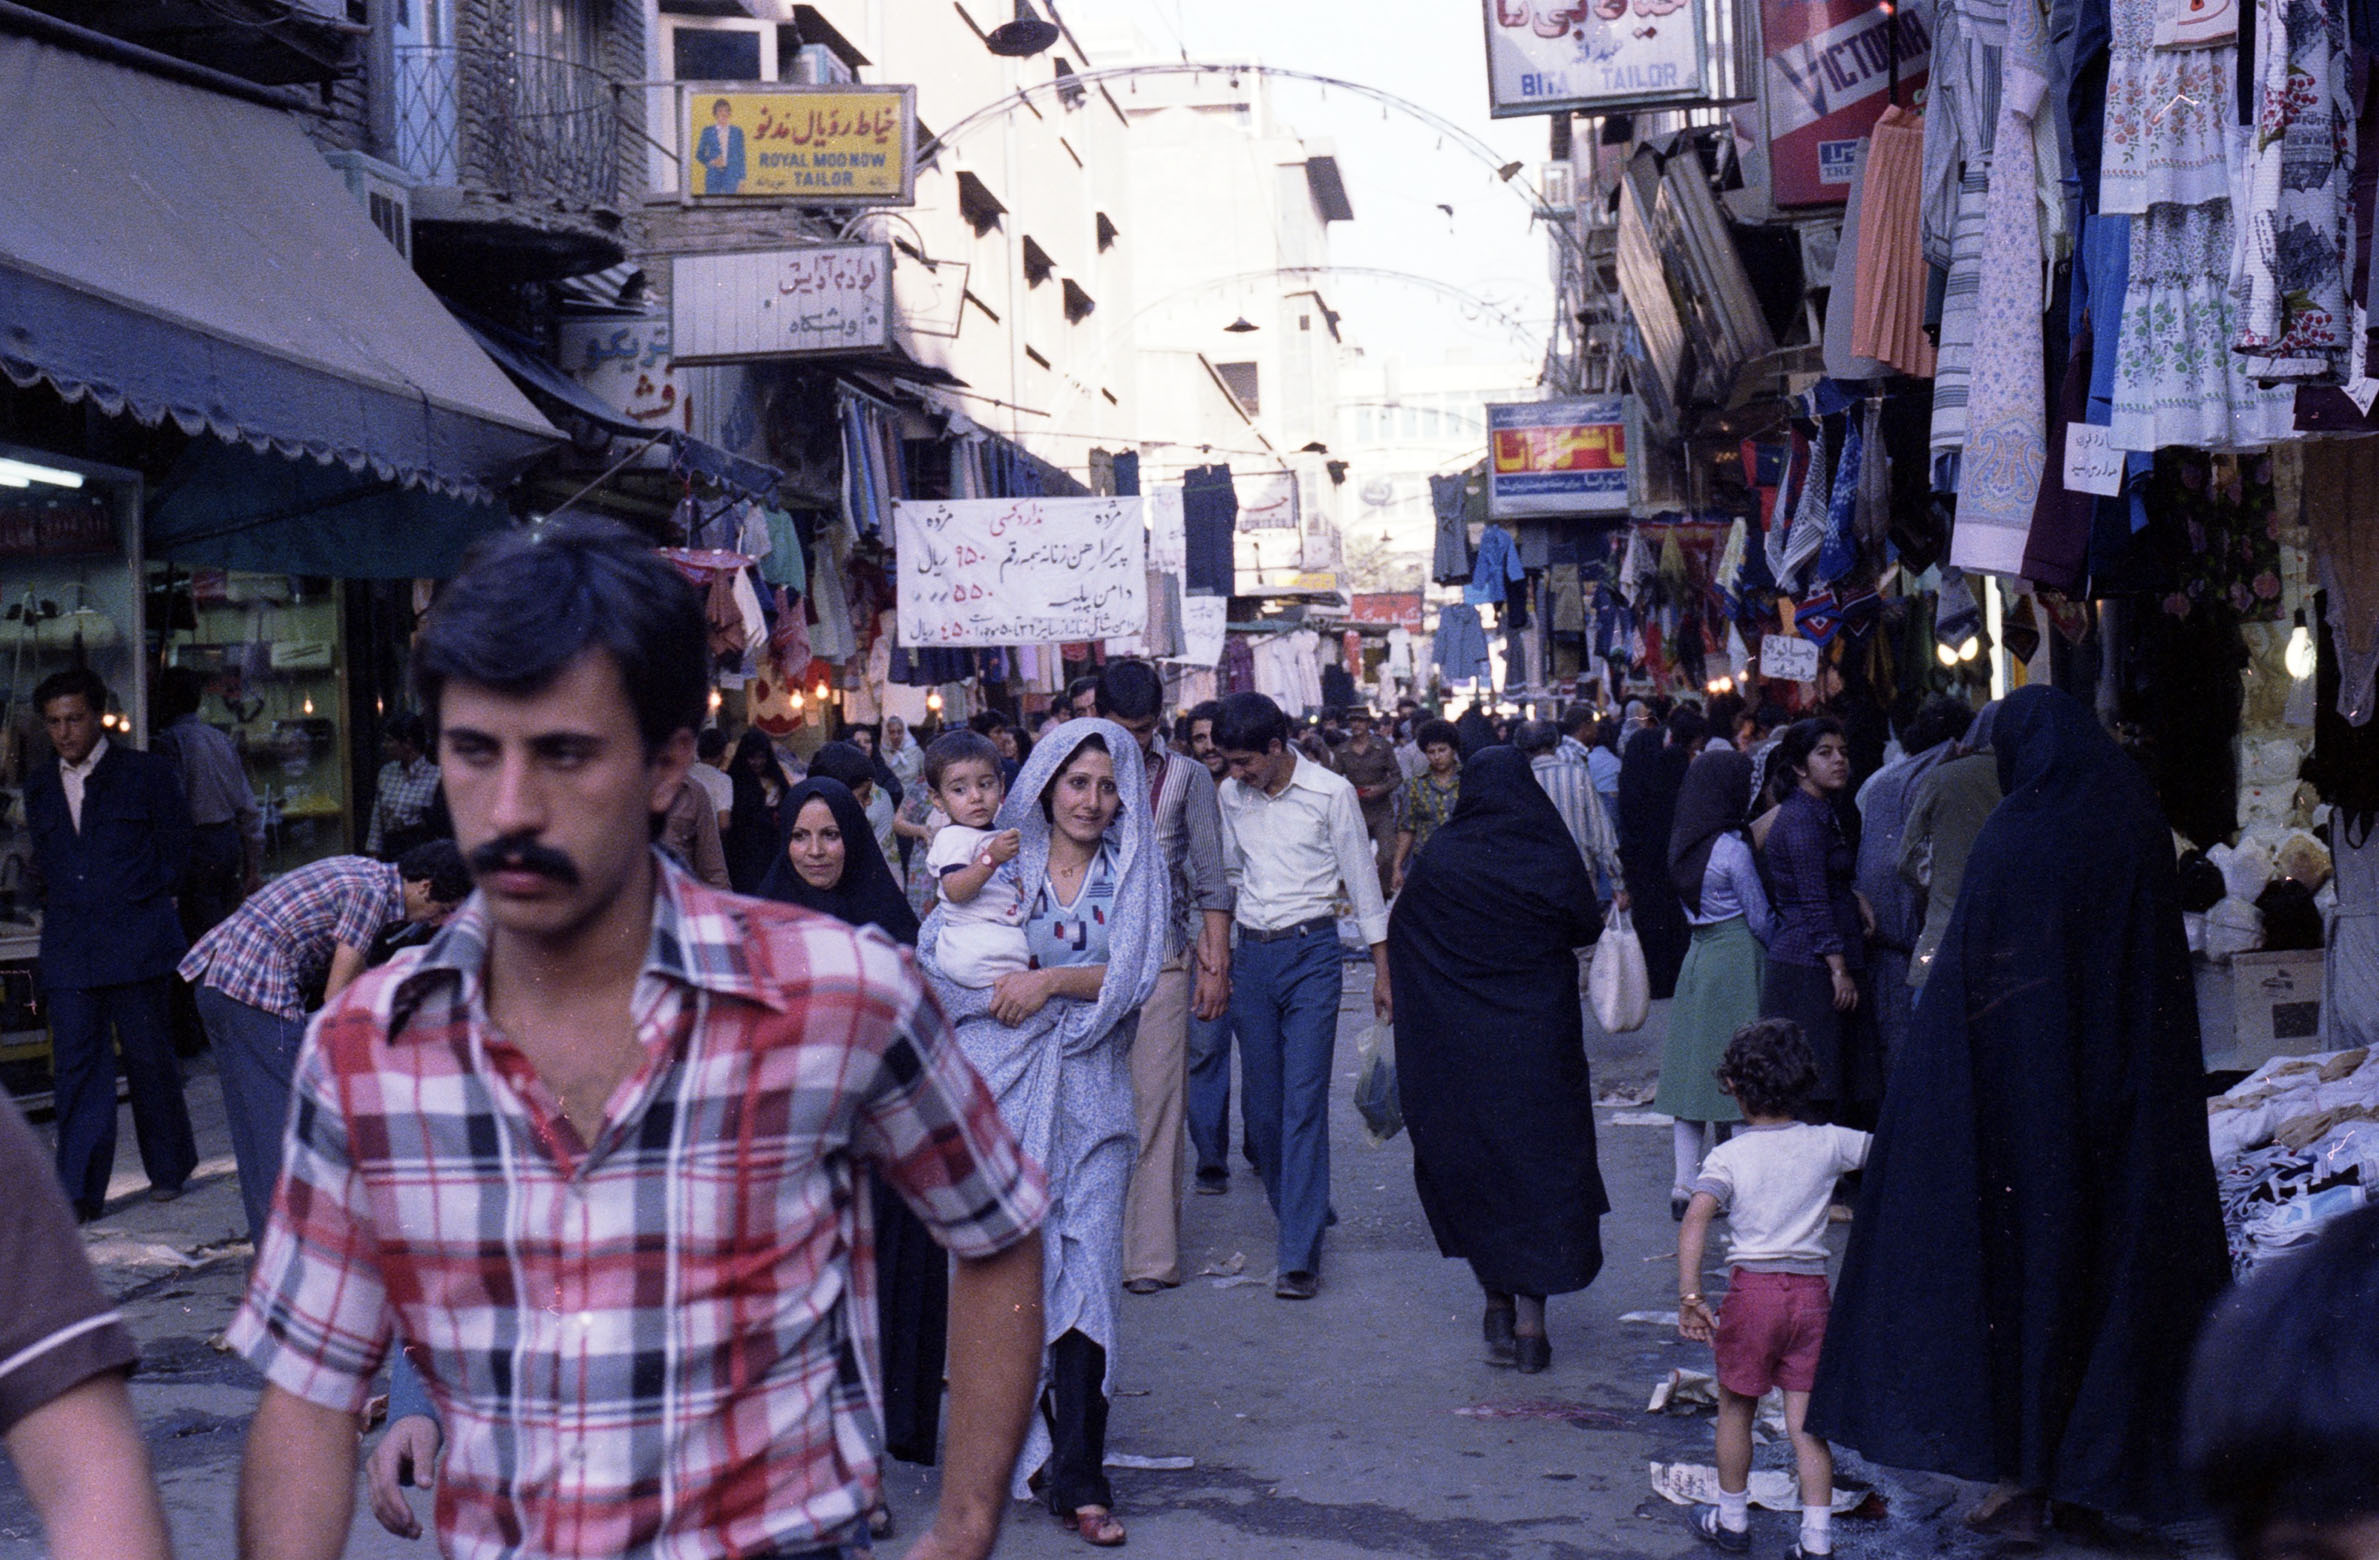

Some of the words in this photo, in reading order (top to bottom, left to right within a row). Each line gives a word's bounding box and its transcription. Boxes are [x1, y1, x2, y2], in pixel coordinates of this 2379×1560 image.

[1521, 71, 1571, 97] BITA
[1602, 62, 1677, 91] TAILOR
[854, 107, 896, 144] خیاط
[758, 152, 808, 168] ROYAL
[794, 171, 853, 188] TAILOR
[778, 254, 836, 295] آرایش
[835, 256, 876, 292] لوازم
[926, 503, 954, 533] مژده
[1095, 500, 1122, 529] مژده
[917, 542, 948, 577] ریال
[954, 544, 987, 569] ۹۵۰
[1039, 544, 1068, 565] زنانه
[1067, 538, 1129, 571] پیراهن
[952, 583, 994, 603] ۵۵۰
[1093, 583, 1133, 609] دامن
[909, 617, 934, 640] ریال
